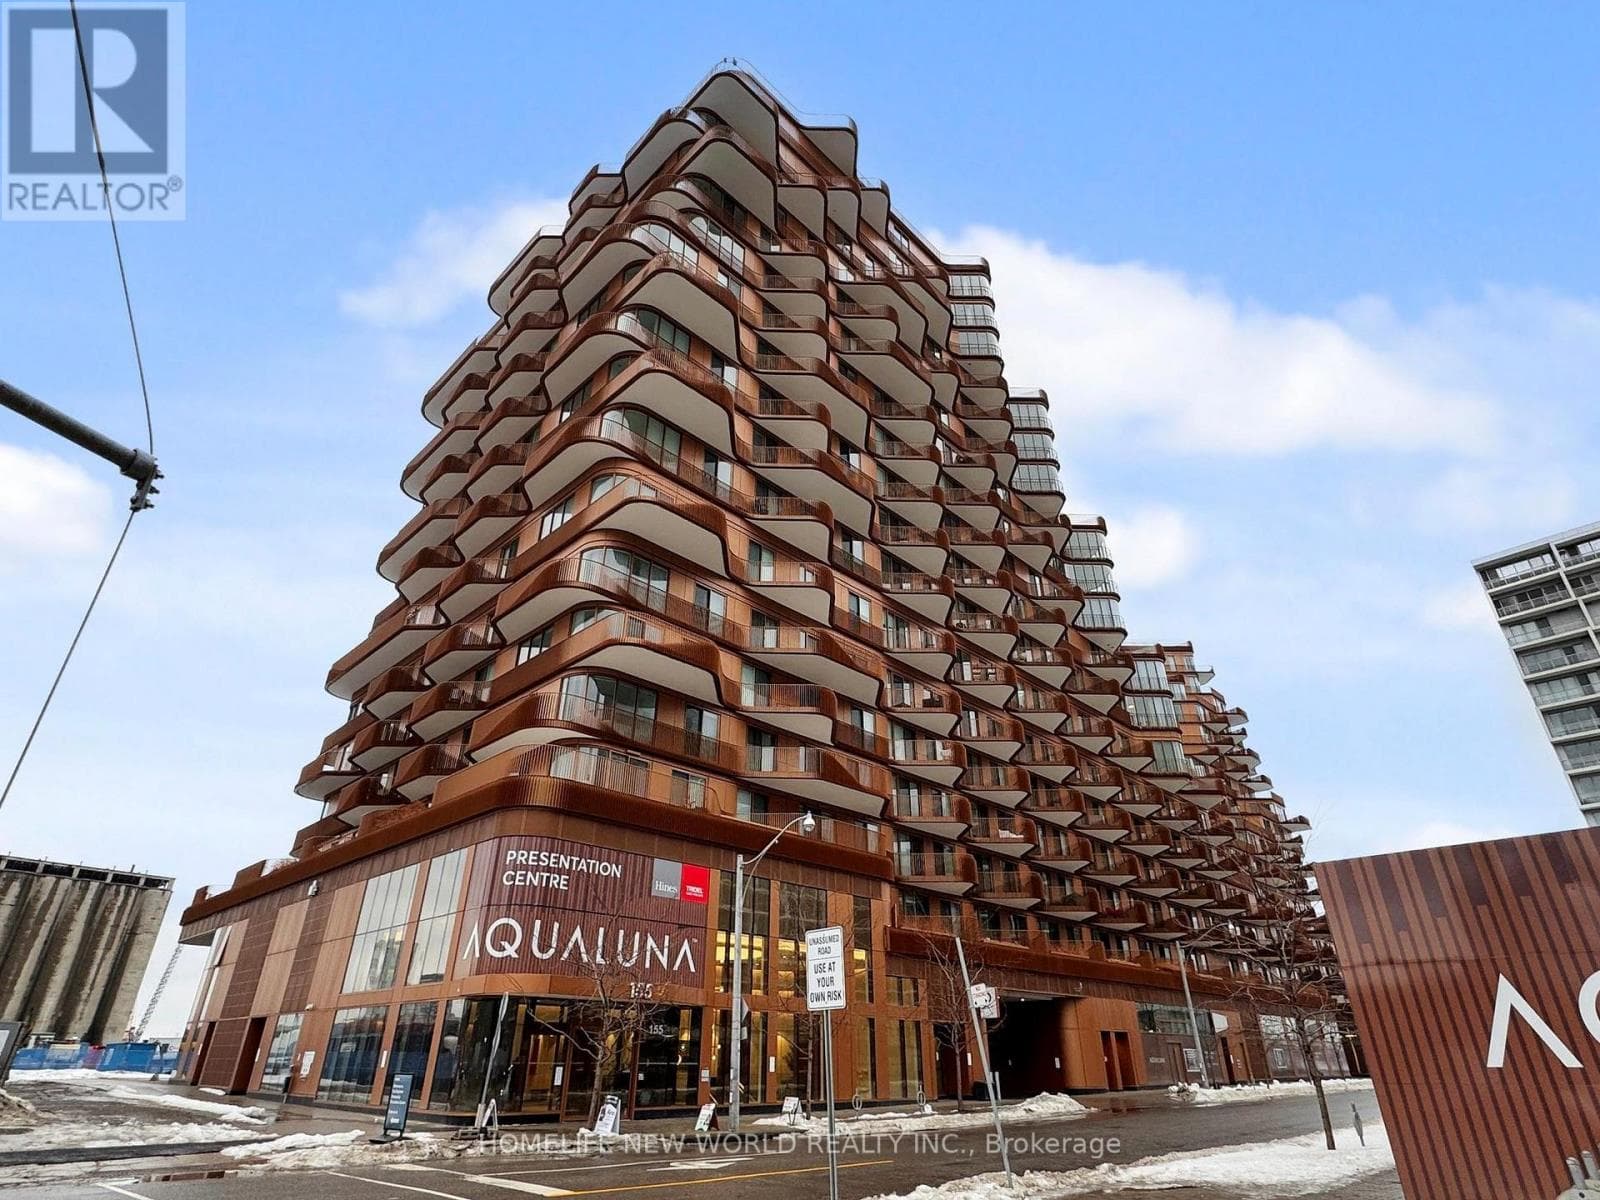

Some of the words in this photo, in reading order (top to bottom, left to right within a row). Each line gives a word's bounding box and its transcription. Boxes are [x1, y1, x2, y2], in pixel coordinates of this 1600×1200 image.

[505, 850, 622, 878] PRESENTATION
[502, 870, 570, 890] CENTRE
[655, 880, 678, 894] Hines
[463, 917, 696, 973] AQUALUNA
[818, 946, 831, 955] ROAD
[814, 963, 826, 974] USE
[828, 961, 836, 972] AT
[816, 976, 834, 988] YOUR
[810, 992, 826, 1003] OWN
[827, 990, 842, 1001] RISK
[1486, 969, 1600, 1068] A
